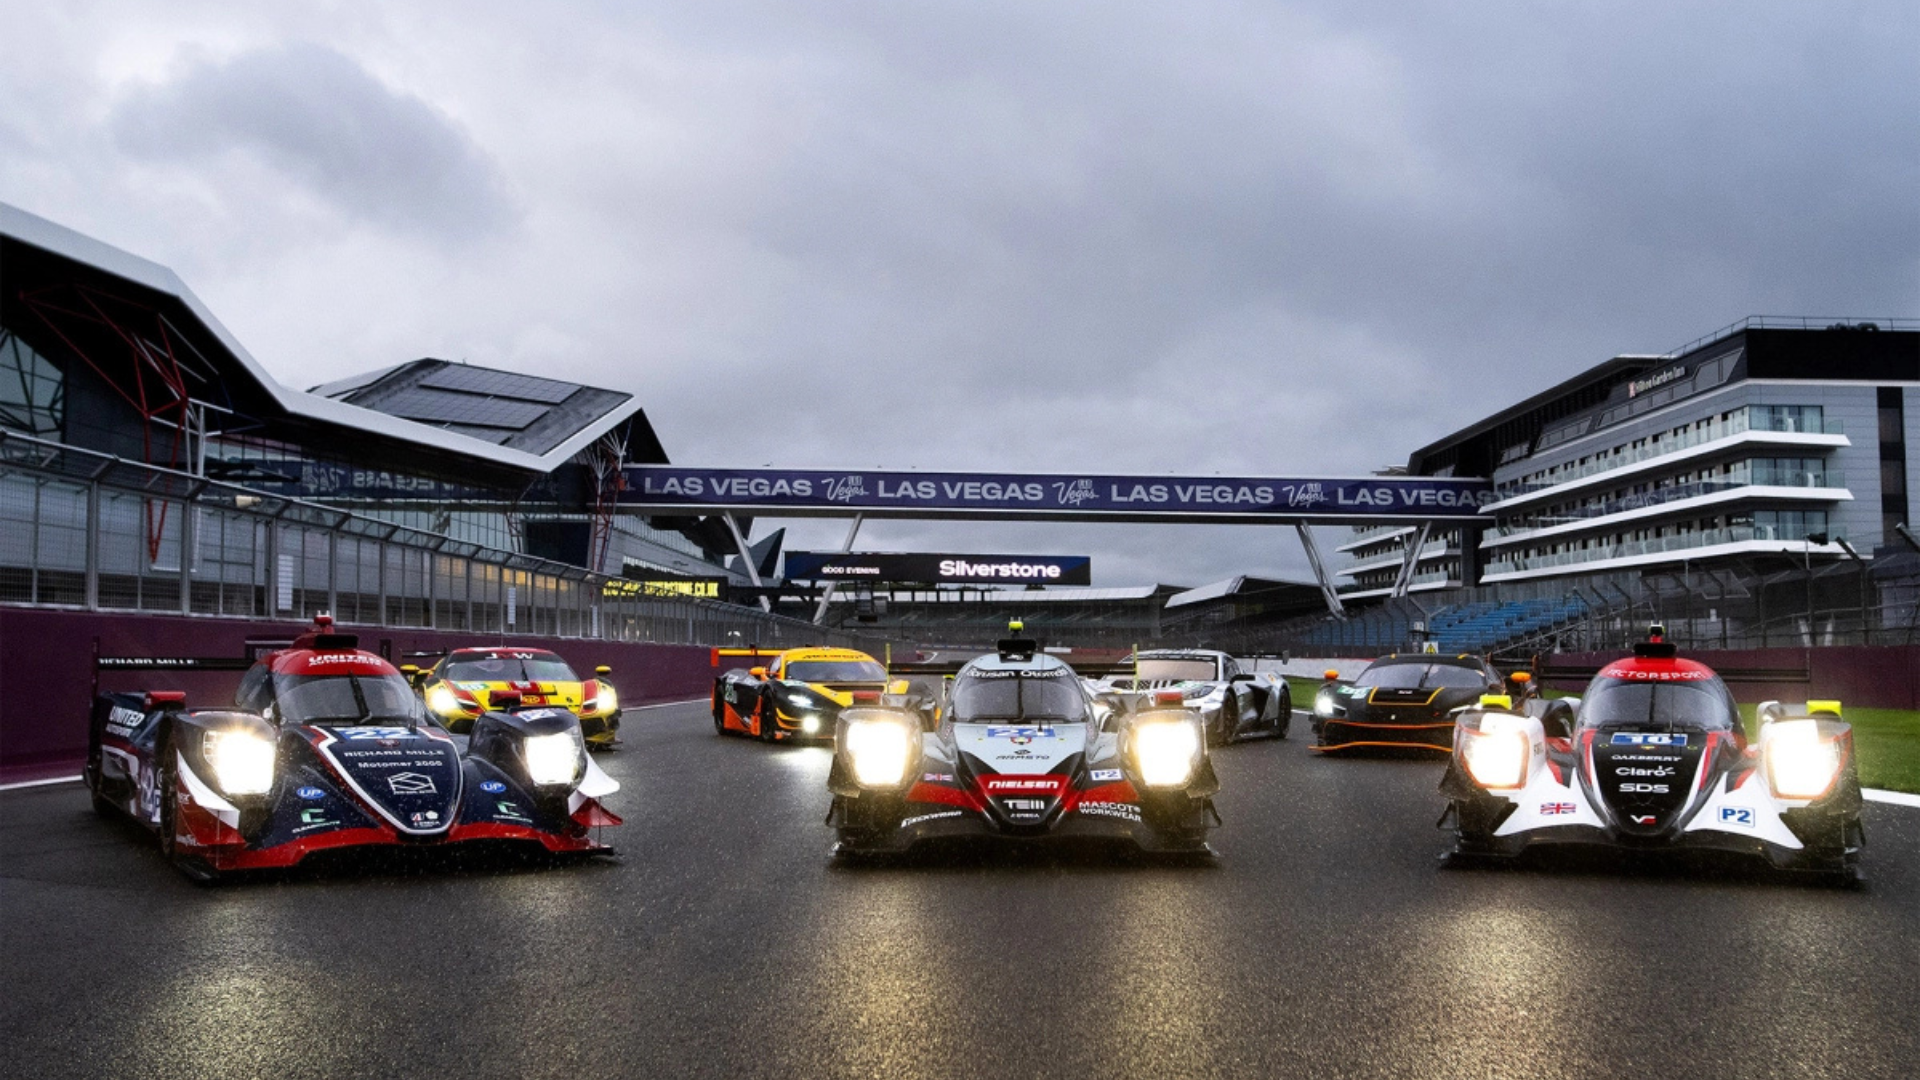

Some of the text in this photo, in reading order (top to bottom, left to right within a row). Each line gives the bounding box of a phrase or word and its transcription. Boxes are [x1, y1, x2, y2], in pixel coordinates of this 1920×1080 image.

[644, 477, 704, 495] LAS
[709, 477, 813, 497] VEGAS
[879, 479, 937, 498] LAS
[942, 481, 1044, 500] VEGAS
[1111, 484, 1170, 502] LAS
[1174, 485, 1274, 503] VEGAS
[1337, 487, 1393, 505] LAS
[939, 560, 1061, 577] Silverstone
[109, 705, 145, 727] UNITED
[345, 749, 445, 758] RICHARD MILLE
[1094, 771, 1119, 779] P2
[988, 781, 1059, 789] NIELSEN
[1619, 783, 1669, 793] SDS
[300, 789, 322, 797] UP
[1080, 808, 1142, 823] WORKWEAR
[1722, 808, 1751, 823] P2
